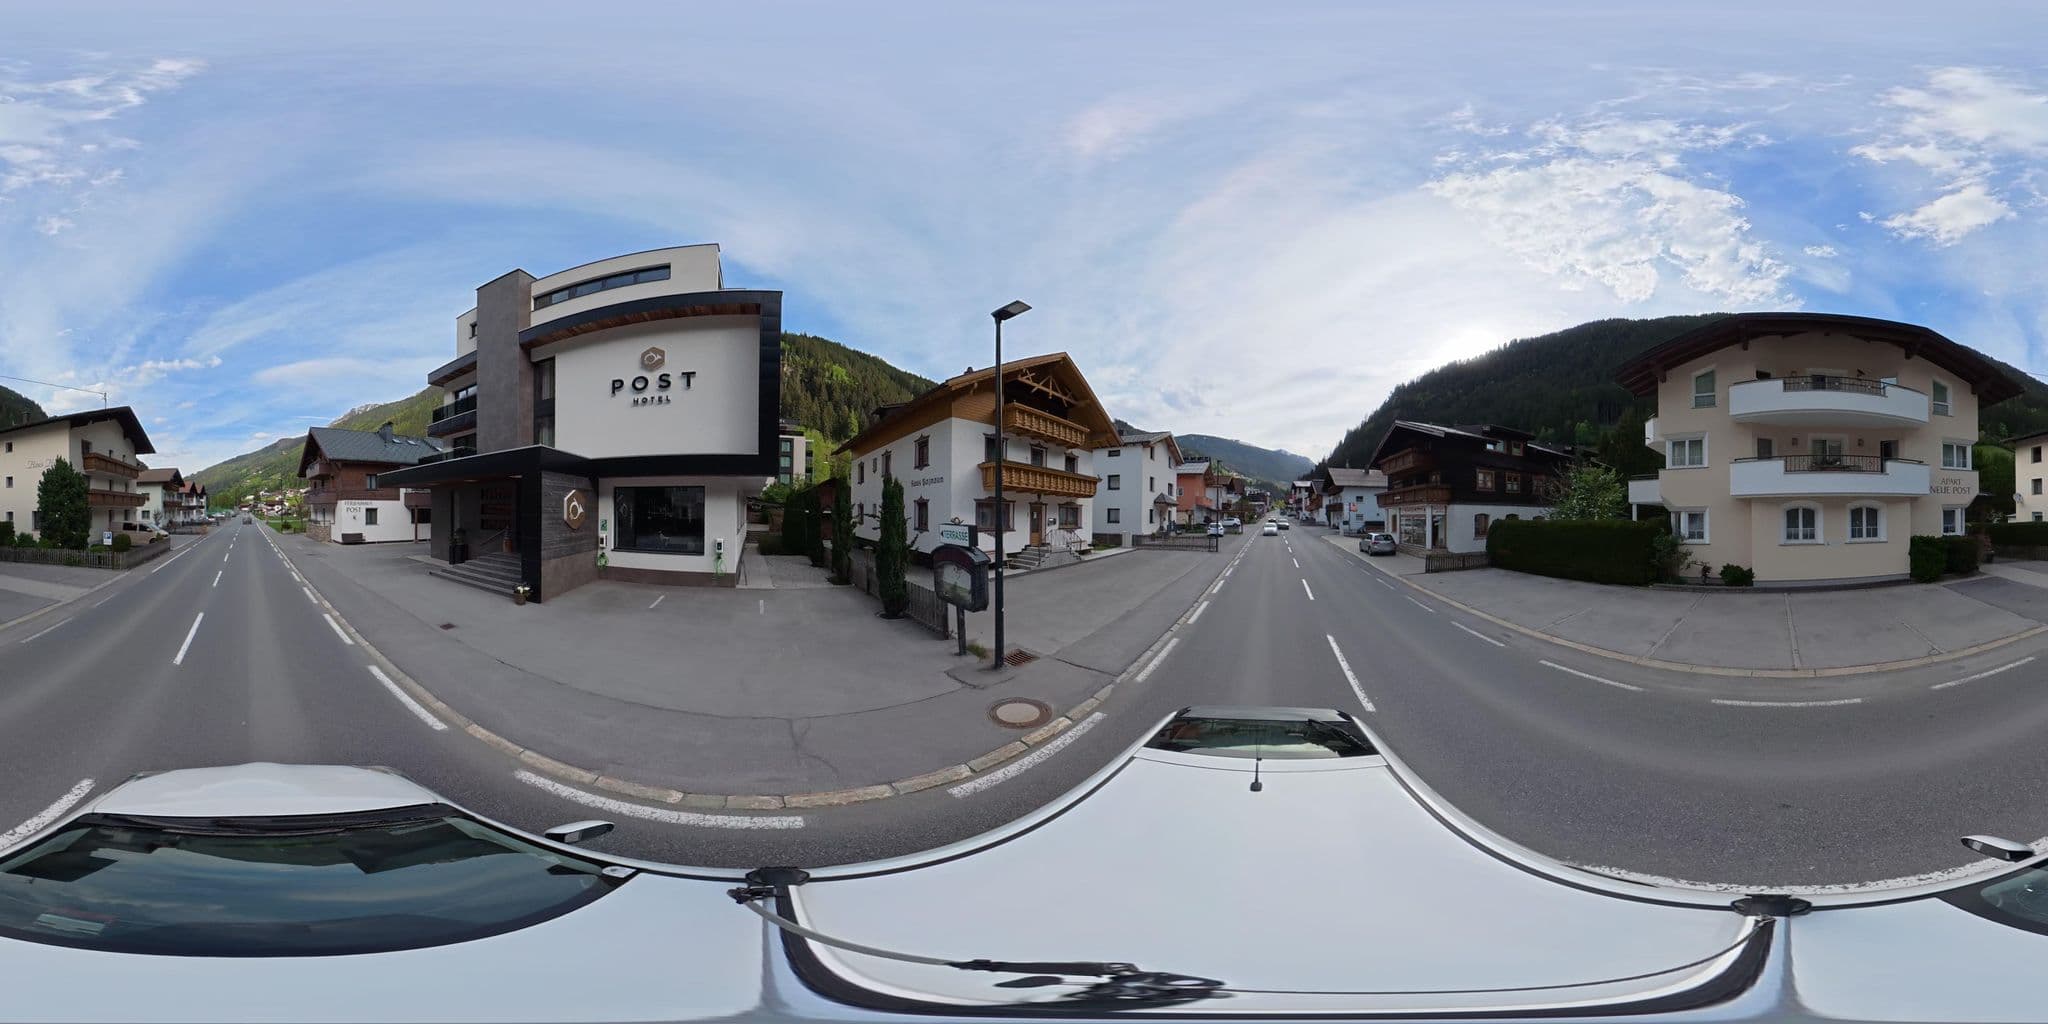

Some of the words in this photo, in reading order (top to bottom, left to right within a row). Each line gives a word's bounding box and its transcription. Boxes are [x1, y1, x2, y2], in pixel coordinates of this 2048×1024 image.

[611, 371, 697, 396] POST
[632, 396, 671, 406] HOTEL
[1930, 486, 1951, 494] NEUE
[1953, 486, 1971, 495] POST
[943, 529, 969, 542] TERRASSE
